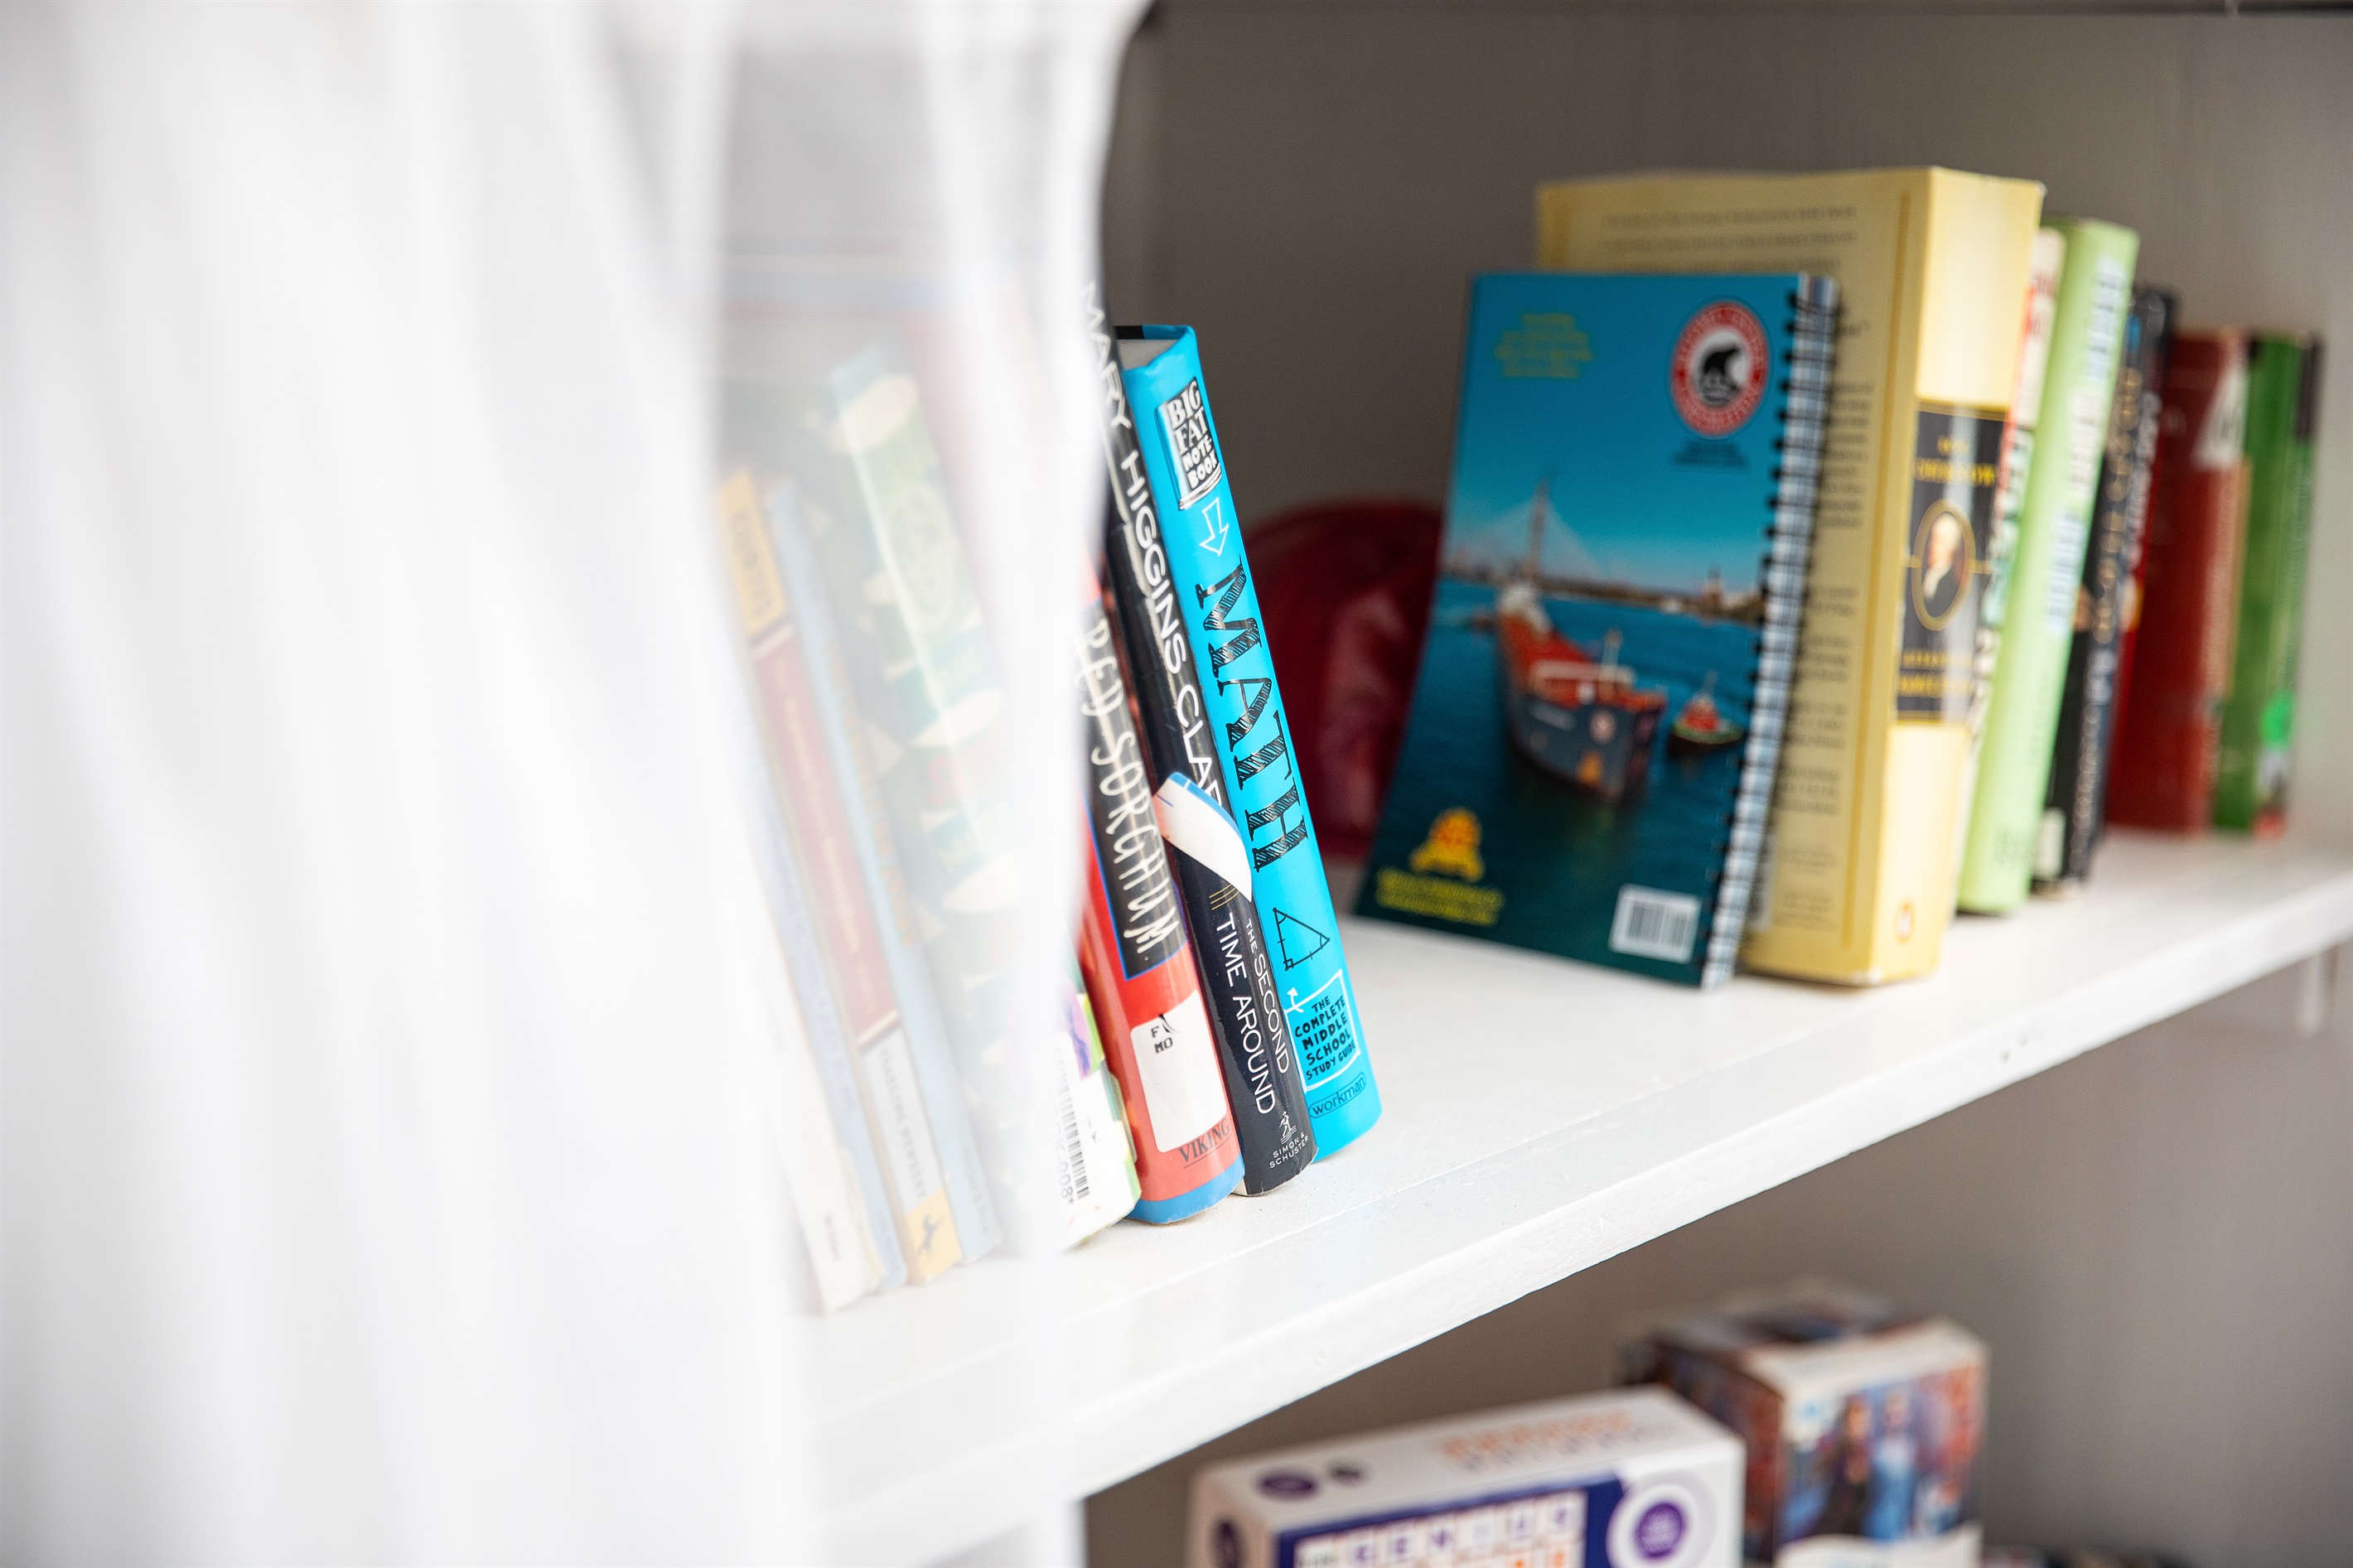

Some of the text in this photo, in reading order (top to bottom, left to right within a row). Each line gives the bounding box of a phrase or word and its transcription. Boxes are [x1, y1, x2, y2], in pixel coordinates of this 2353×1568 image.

[1167, 380, 1201, 430] BIG
[1174, 405, 1208, 456] FAT
[1080, 279, 1132, 429] MARY
[1121, 450, 1187, 675] HIGGINS
[1187, 450, 1218, 490] BOOK
[1196, 554, 1309, 872] MATH
[1090, 730, 1180, 954] SORGHUM
[1215, 912, 1276, 1115] TIME AROUND
[1246, 918, 1290, 1075] THE SECOND
[1294, 995, 1346, 1038] COMPLETE
[1312, 996, 1331, 1014] THE
[1154, 1037, 1173, 1054] MO
[1301, 1012, 1348, 1051] MIDDLE
[1306, 1028, 1351, 1066] SCHOOL
[1305, 1040, 1356, 1081] STUDY GUIDE
[1312, 1077, 1366, 1116] workman
[1178, 1117, 1230, 1163] VIKING
[1269, 1135, 1309, 1169] SCHUSTER
[1273, 1136, 1300, 1158] SIMON
